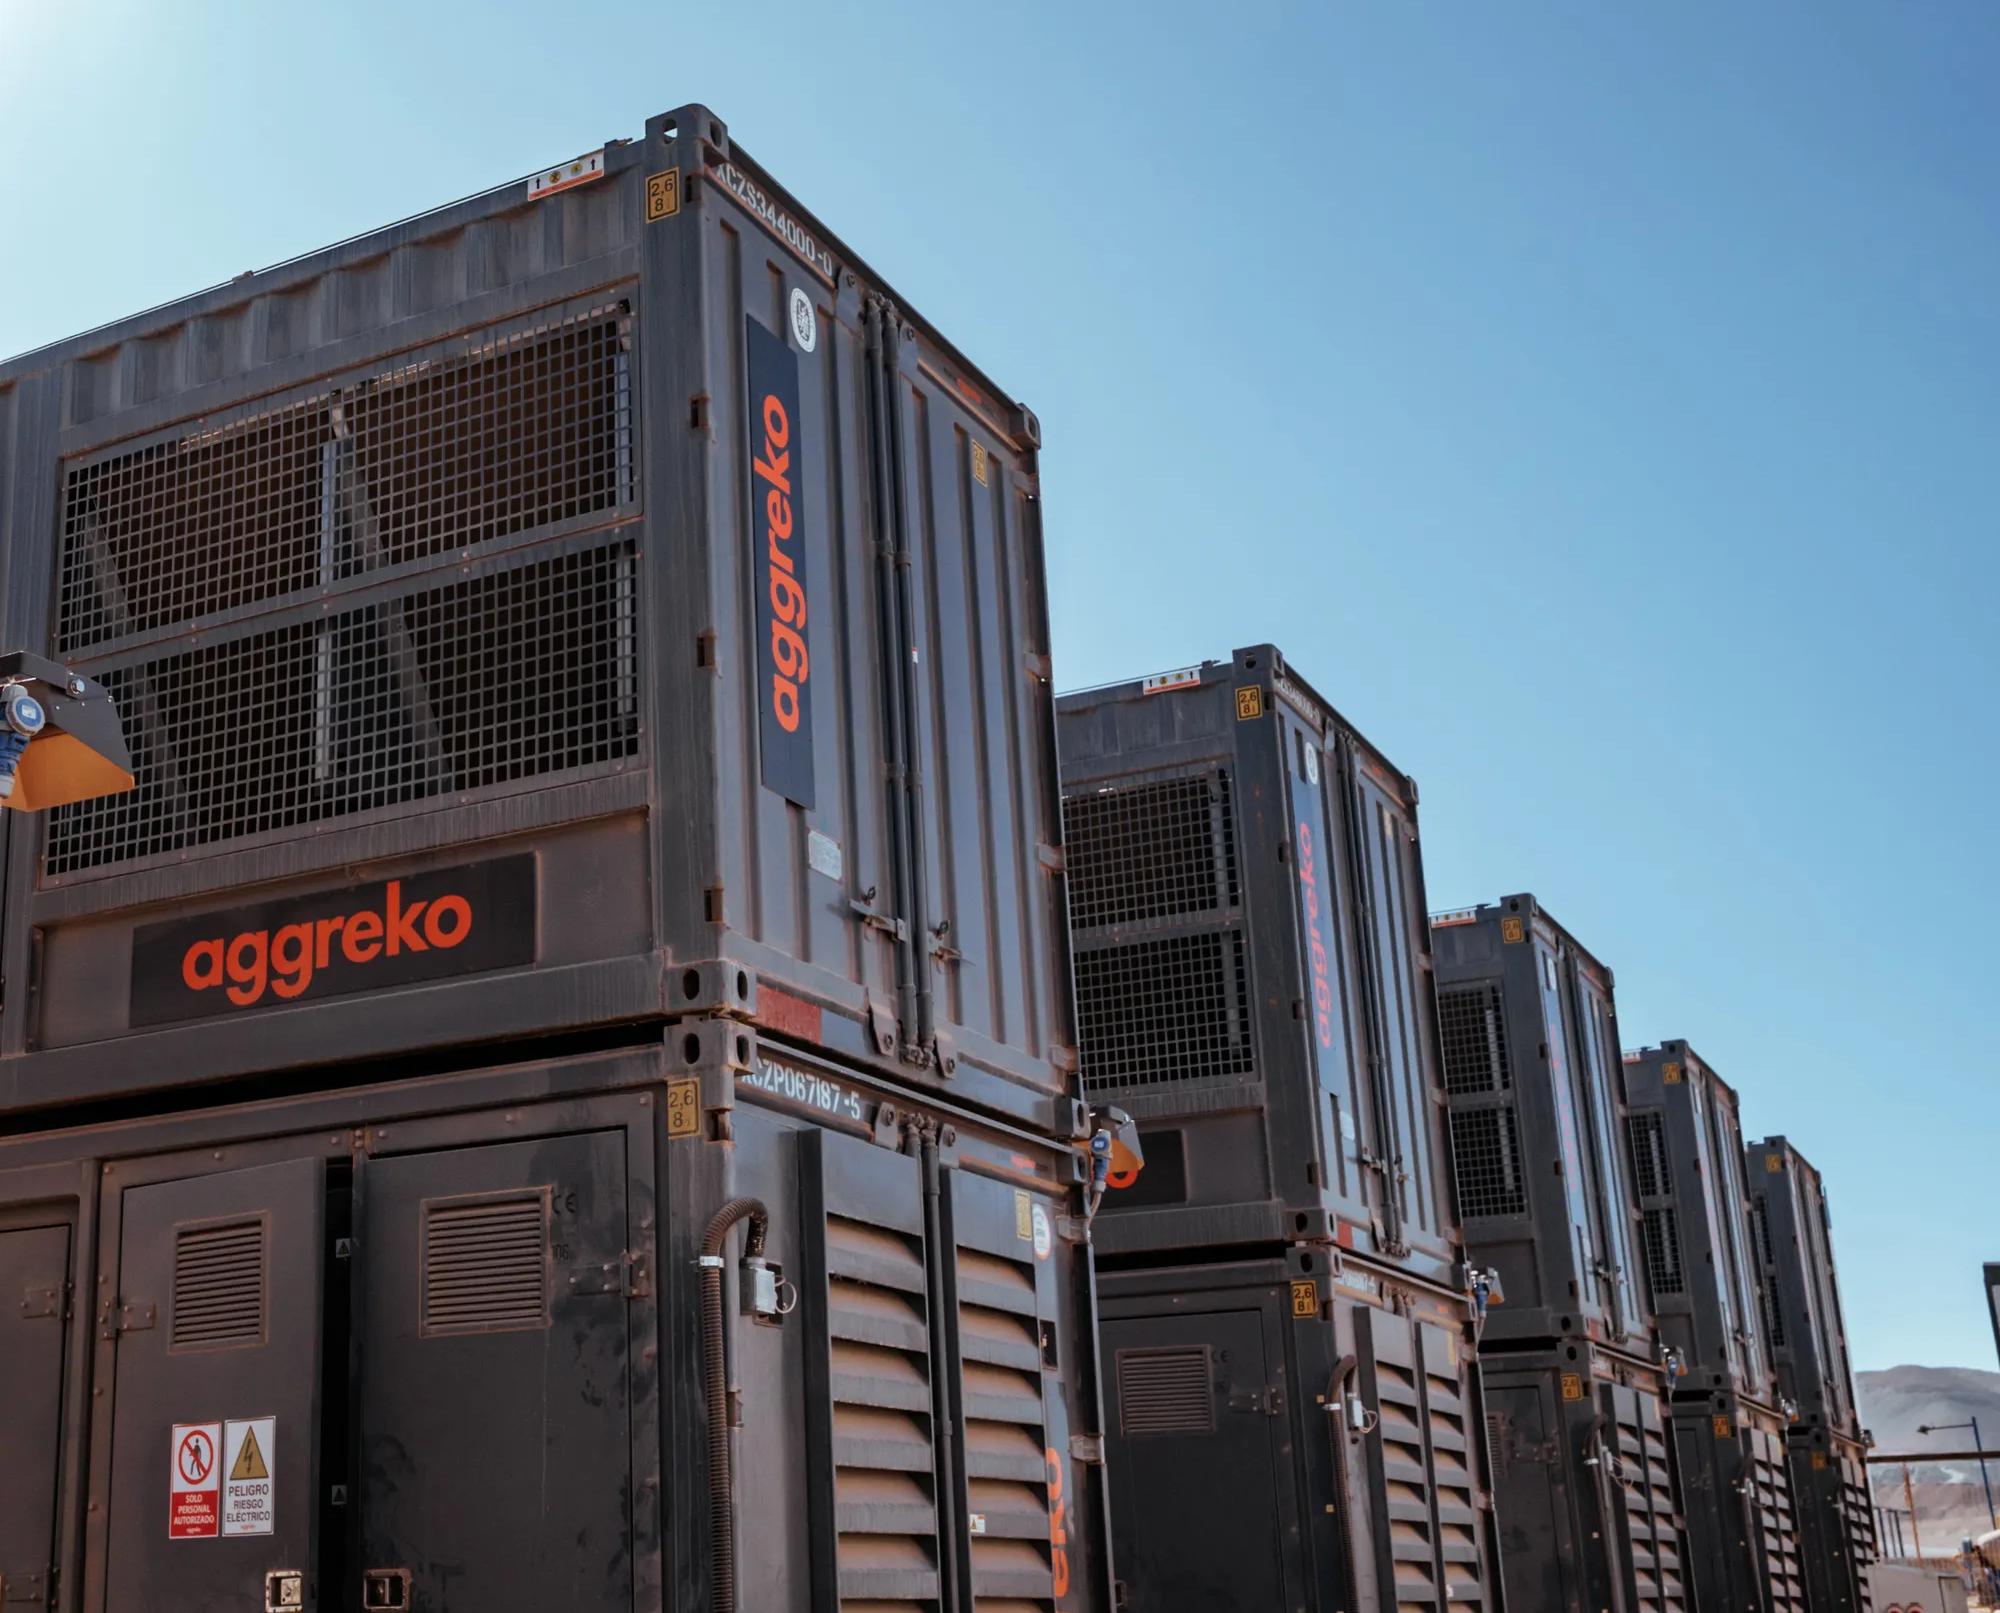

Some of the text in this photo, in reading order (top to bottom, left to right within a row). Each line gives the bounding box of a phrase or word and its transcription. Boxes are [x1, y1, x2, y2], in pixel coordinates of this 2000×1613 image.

[754, 394, 808, 733] aggreko
[182, 880, 472, 1006] aggreko
[669, 1089, 693, 1109] 2,6
[228, 1484, 269, 1497] PELIGRO
[185, 1494, 203, 1504] SOLO
[233, 1499, 264, 1510] RIESGO
[177, 1504, 211, 1514] PERSONAL
[173, 1515, 215, 1525] AUTORIZADO
